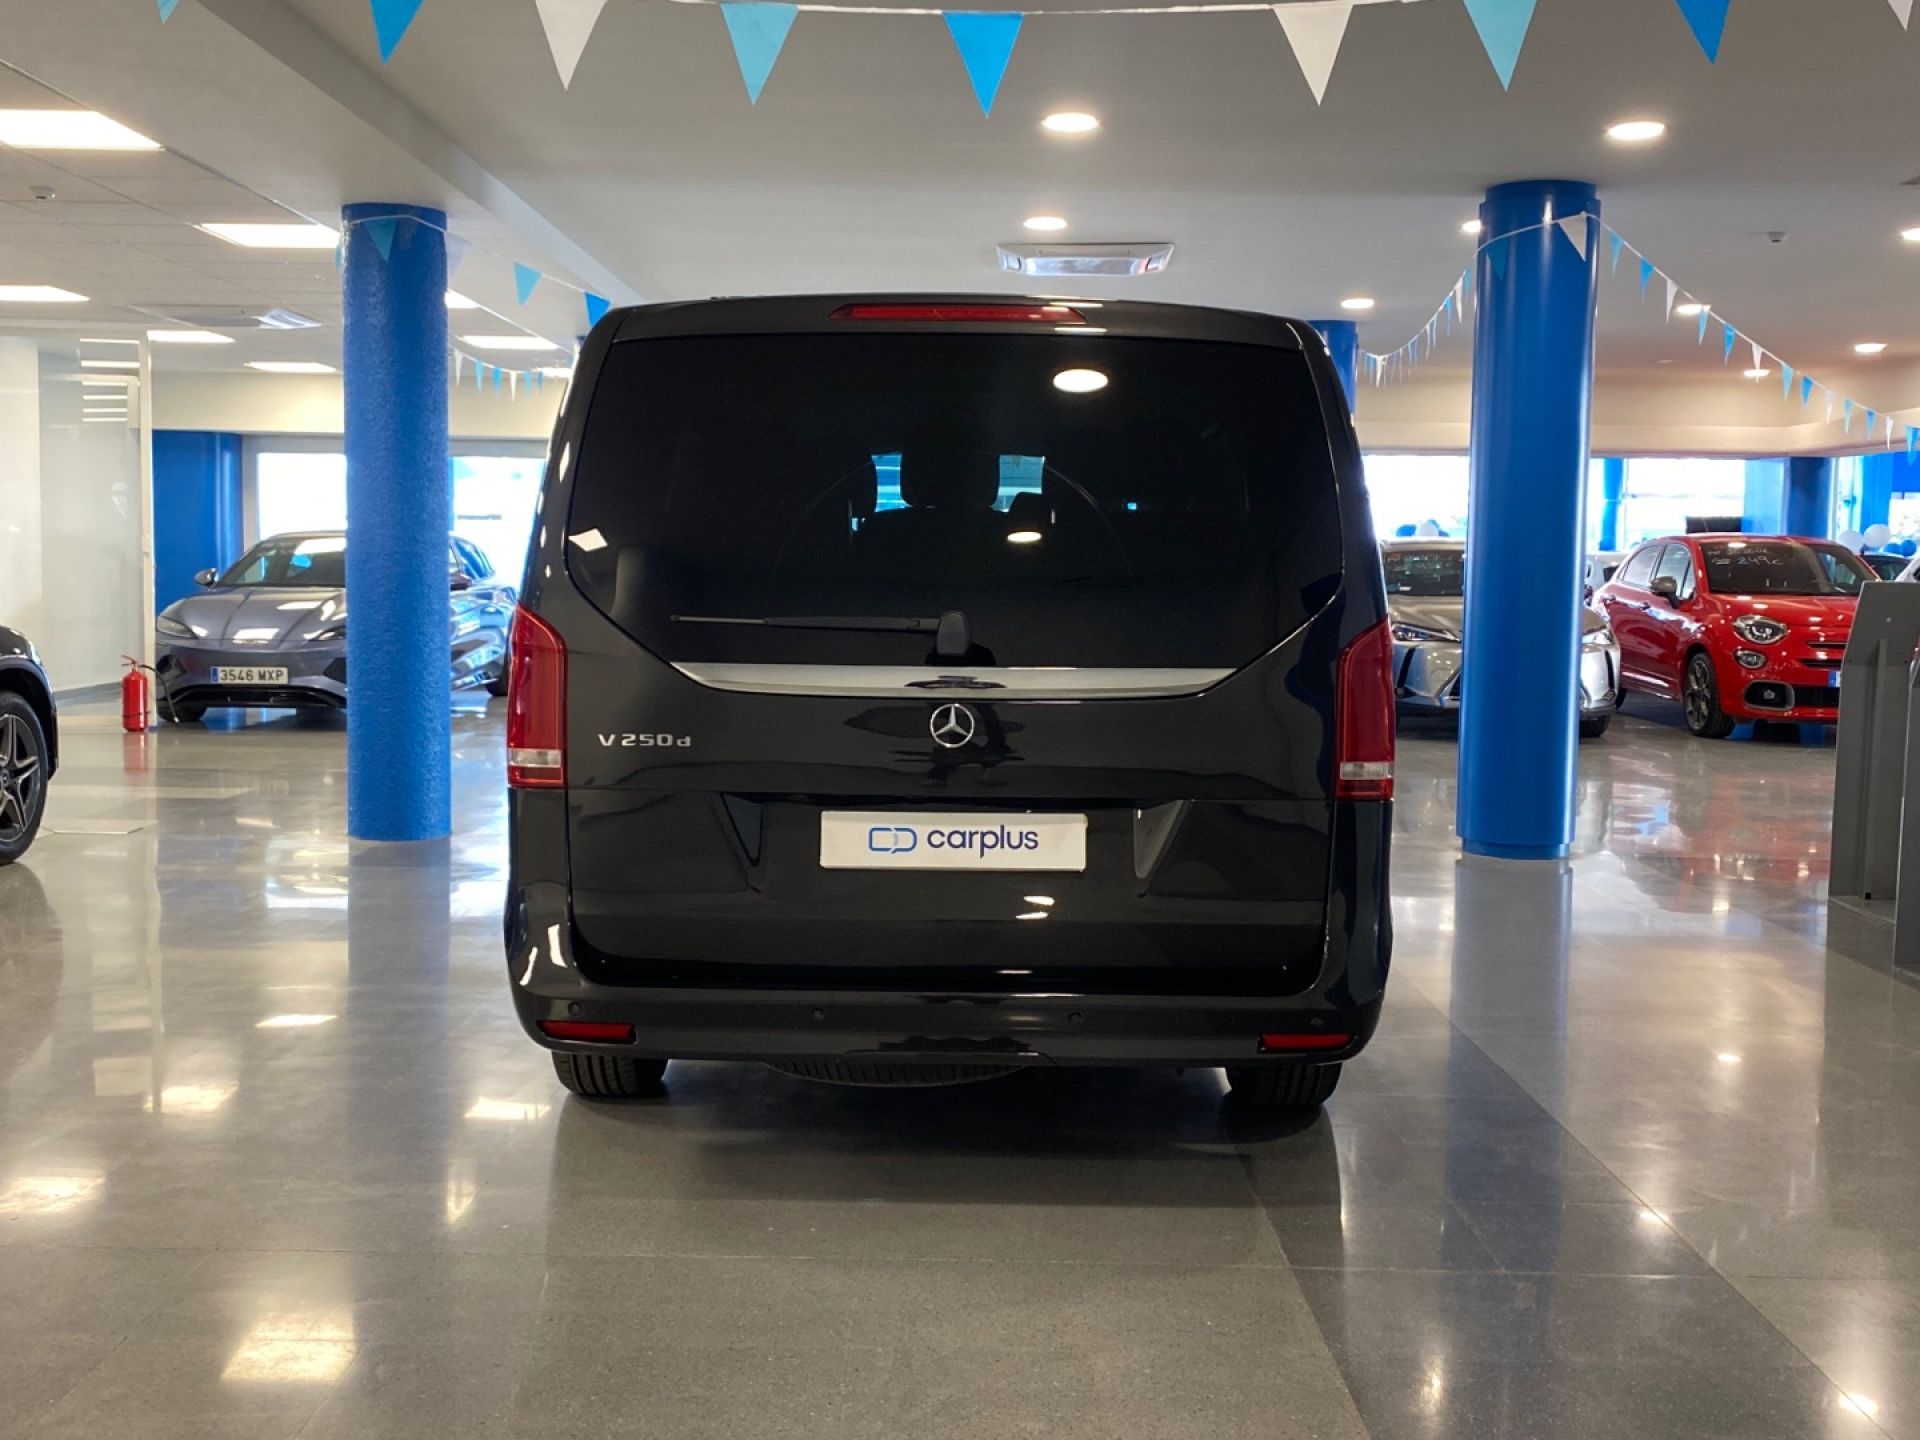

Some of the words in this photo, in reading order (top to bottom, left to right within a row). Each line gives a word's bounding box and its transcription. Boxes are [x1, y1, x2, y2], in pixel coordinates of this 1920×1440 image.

[220, 669, 254, 681] 3546
[258, 669, 284, 681] MXP
[598, 733, 616, 747] V
[927, 824, 1039, 859] carplus
